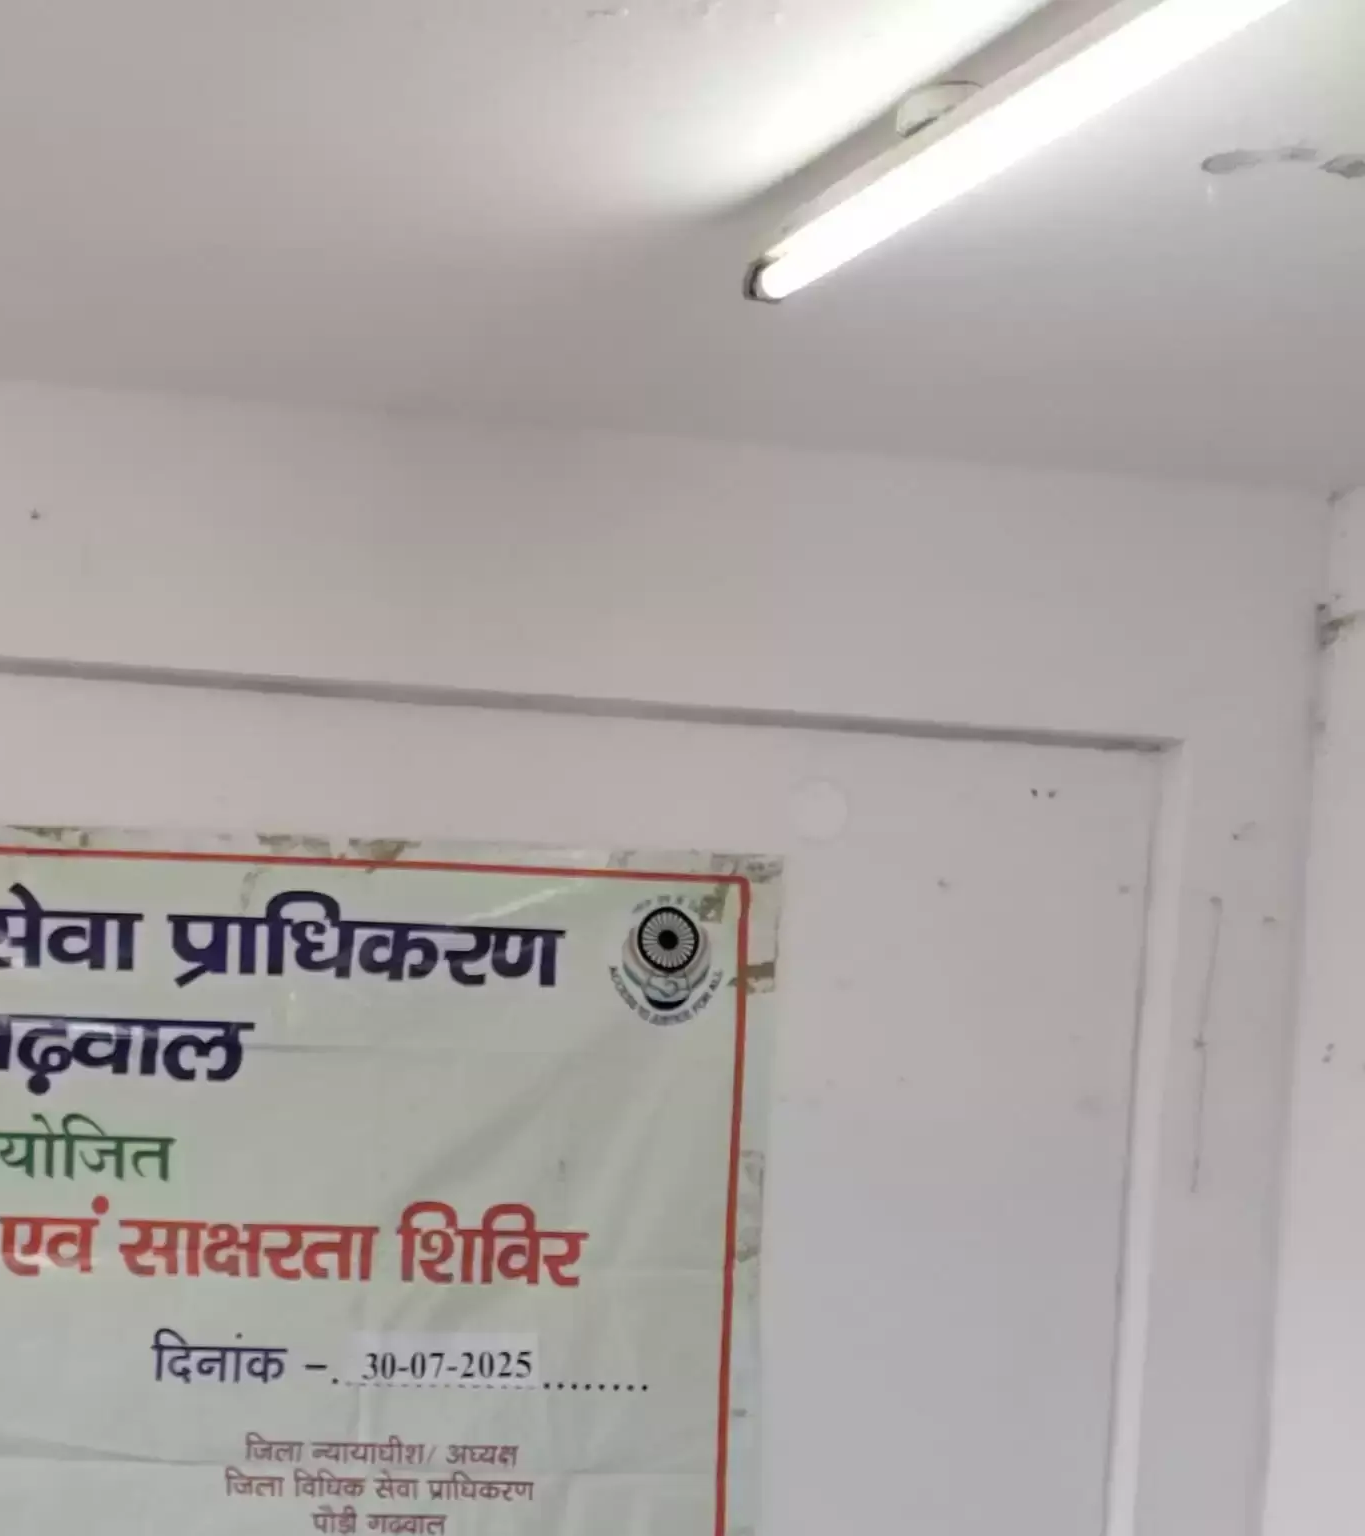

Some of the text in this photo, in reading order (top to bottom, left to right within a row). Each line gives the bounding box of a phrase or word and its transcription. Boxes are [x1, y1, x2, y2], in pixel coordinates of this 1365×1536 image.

[167, 889, 567, 988] प्राधिकरण
[0, 1194, 111, 1276] एवं
[118, 1218, 380, 1284] साक्षरता
[397, 1200, 591, 1288] शिविर
[150, 1327, 534, 1385] दिनांक 30-07-2025
[244, 1431, 305, 1464] जिला
[445, 1444, 520, 1468] अध्यक्ष
[224, 1466, 535, 1503] जिला विधिक सेवा प्राधिकरण
